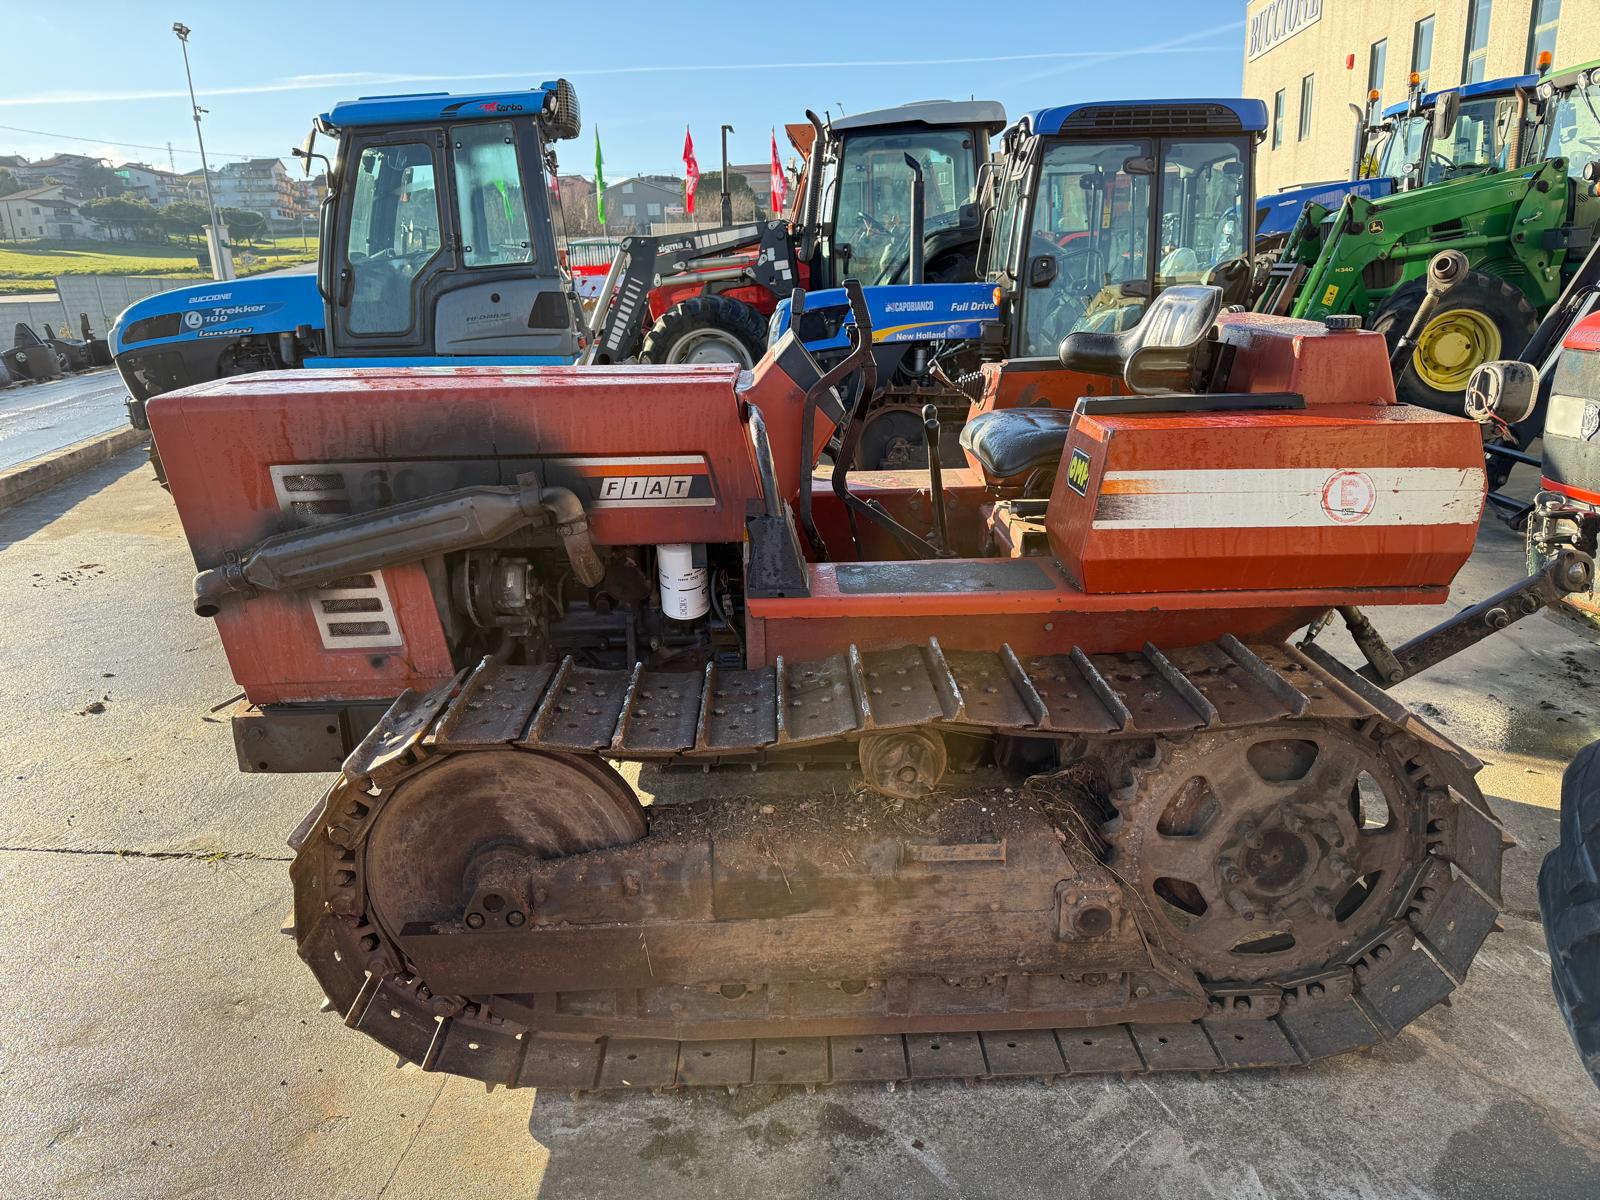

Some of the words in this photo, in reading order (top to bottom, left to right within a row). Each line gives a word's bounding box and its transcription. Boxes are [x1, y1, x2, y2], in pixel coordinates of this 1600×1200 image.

[658, 242, 684, 253] sigma
[685, 241, 692, 249] 4
[213, 304, 266, 316] Trekker
[895, 300, 934, 312] CAPOBIANCO
[951, 302, 969, 312] Full
[971, 301, 996, 311] Drive
[204, 315, 228, 323] 100
[199, 328, 252, 337] Landini
[896, 332, 914, 341] New
[916, 330, 946, 340] Holland
[606, 480, 686, 496] FIAT
